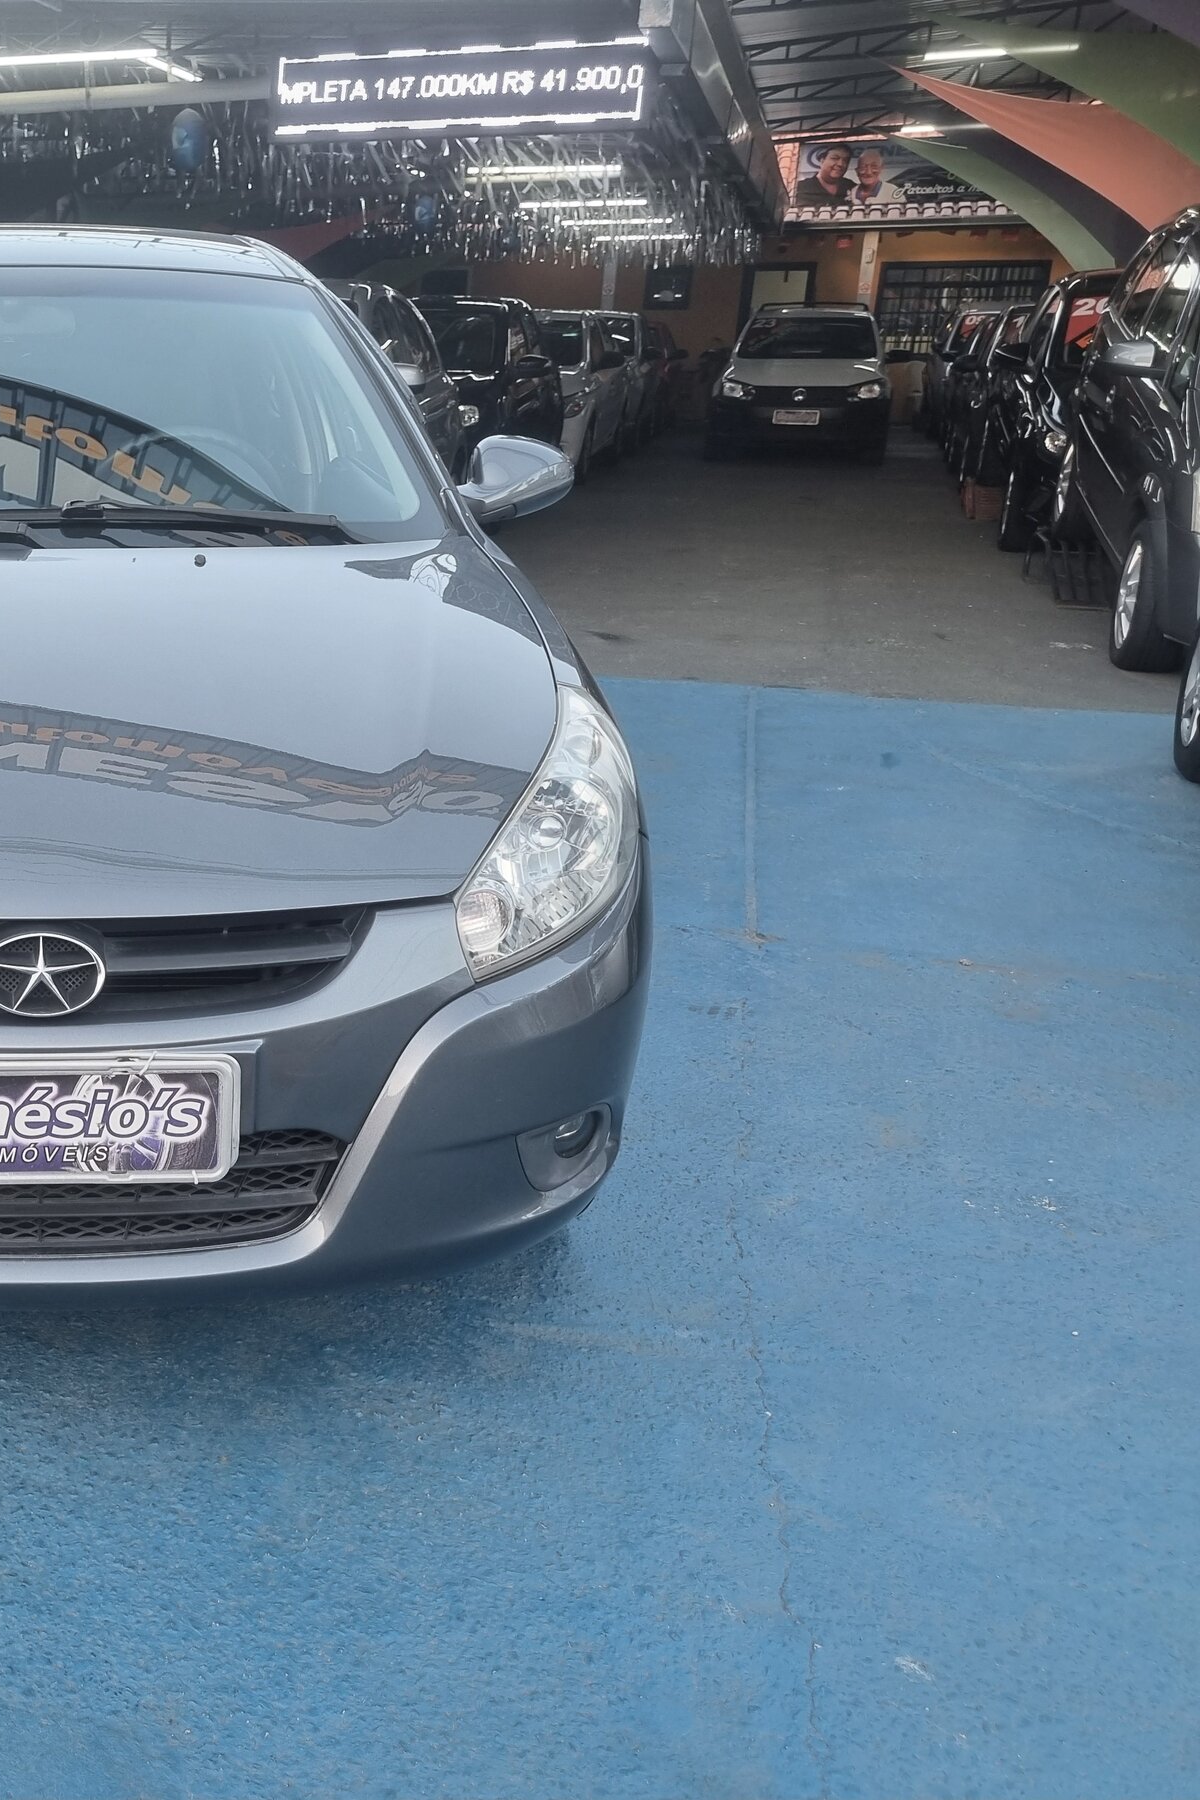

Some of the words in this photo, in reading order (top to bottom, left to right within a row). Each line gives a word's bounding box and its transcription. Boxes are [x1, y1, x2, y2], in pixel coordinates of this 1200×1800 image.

[280, 78, 367, 104] MPLETA
[374, 73, 497, 100] 147.000KM
[502, 70, 536, 96] R$
[540, 65, 644, 94] 41.900,0
